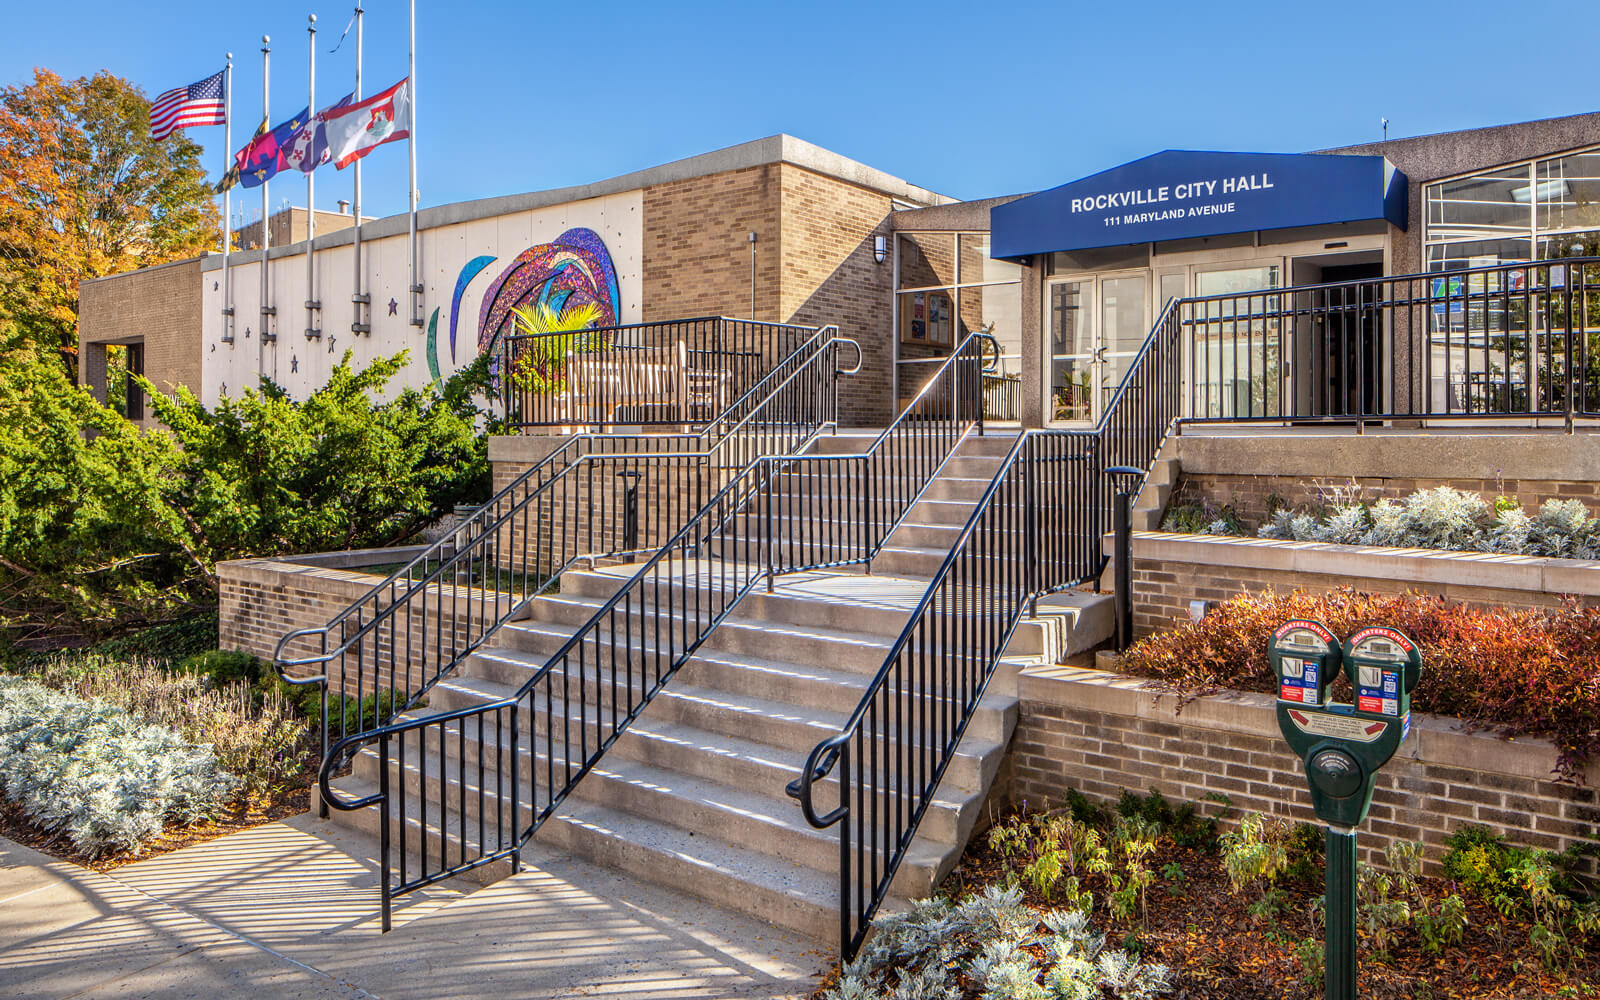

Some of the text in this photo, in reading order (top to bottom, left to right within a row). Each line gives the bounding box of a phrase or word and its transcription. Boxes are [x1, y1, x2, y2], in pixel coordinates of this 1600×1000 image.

[1071, 173, 1274, 213] ROCKVILLE CITY HALL
[1104, 202, 1235, 227] 111 MARYLAND AVENUE
[1277, 621, 1331, 641] QUARTERS ONLY!
[1352, 629, 1411, 649] QUARTERS ONLY!
